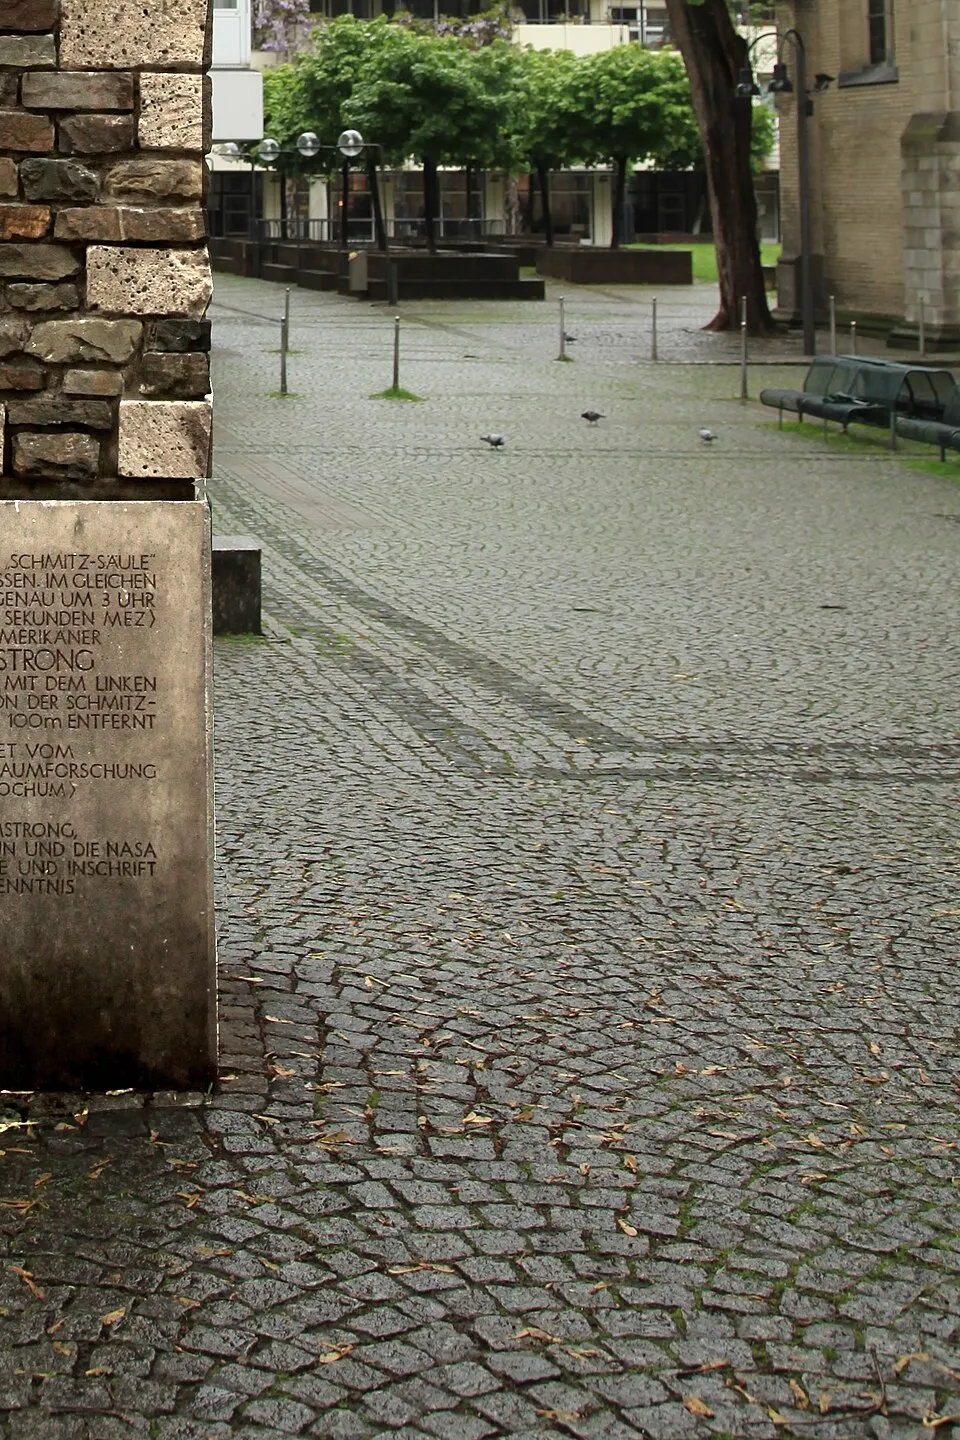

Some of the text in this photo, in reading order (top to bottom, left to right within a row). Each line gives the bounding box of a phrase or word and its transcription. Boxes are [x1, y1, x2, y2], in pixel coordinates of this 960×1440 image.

[45, 573, 68, 589] IM
[72, 573, 157, 589] GLEICHEN
[61, 592, 93, 607] UM
[101, 592, 110, 607] 3
[118, 592, 156, 607] UHR
[5, 610, 95, 627] SEKUNDEN
[4, 675, 38, 691] MIT
[45, 675, 86, 691] DEM
[95, 676, 157, 692] LINKEN
[27, 694, 59, 710] DER
[66, 695, 157, 711] SCHMITZ-
[7, 713, 62, 729] 100m
[67, 713, 157, 729] ENTFERNT
[25, 743, 74, 759] VOM
[25, 841, 66, 857] UND
[73, 842, 100, 857] DIE
[106, 841, 157, 858] NASA
[18, 860, 58, 876] UND
[67, 860, 157, 877] INSCHRIFT
